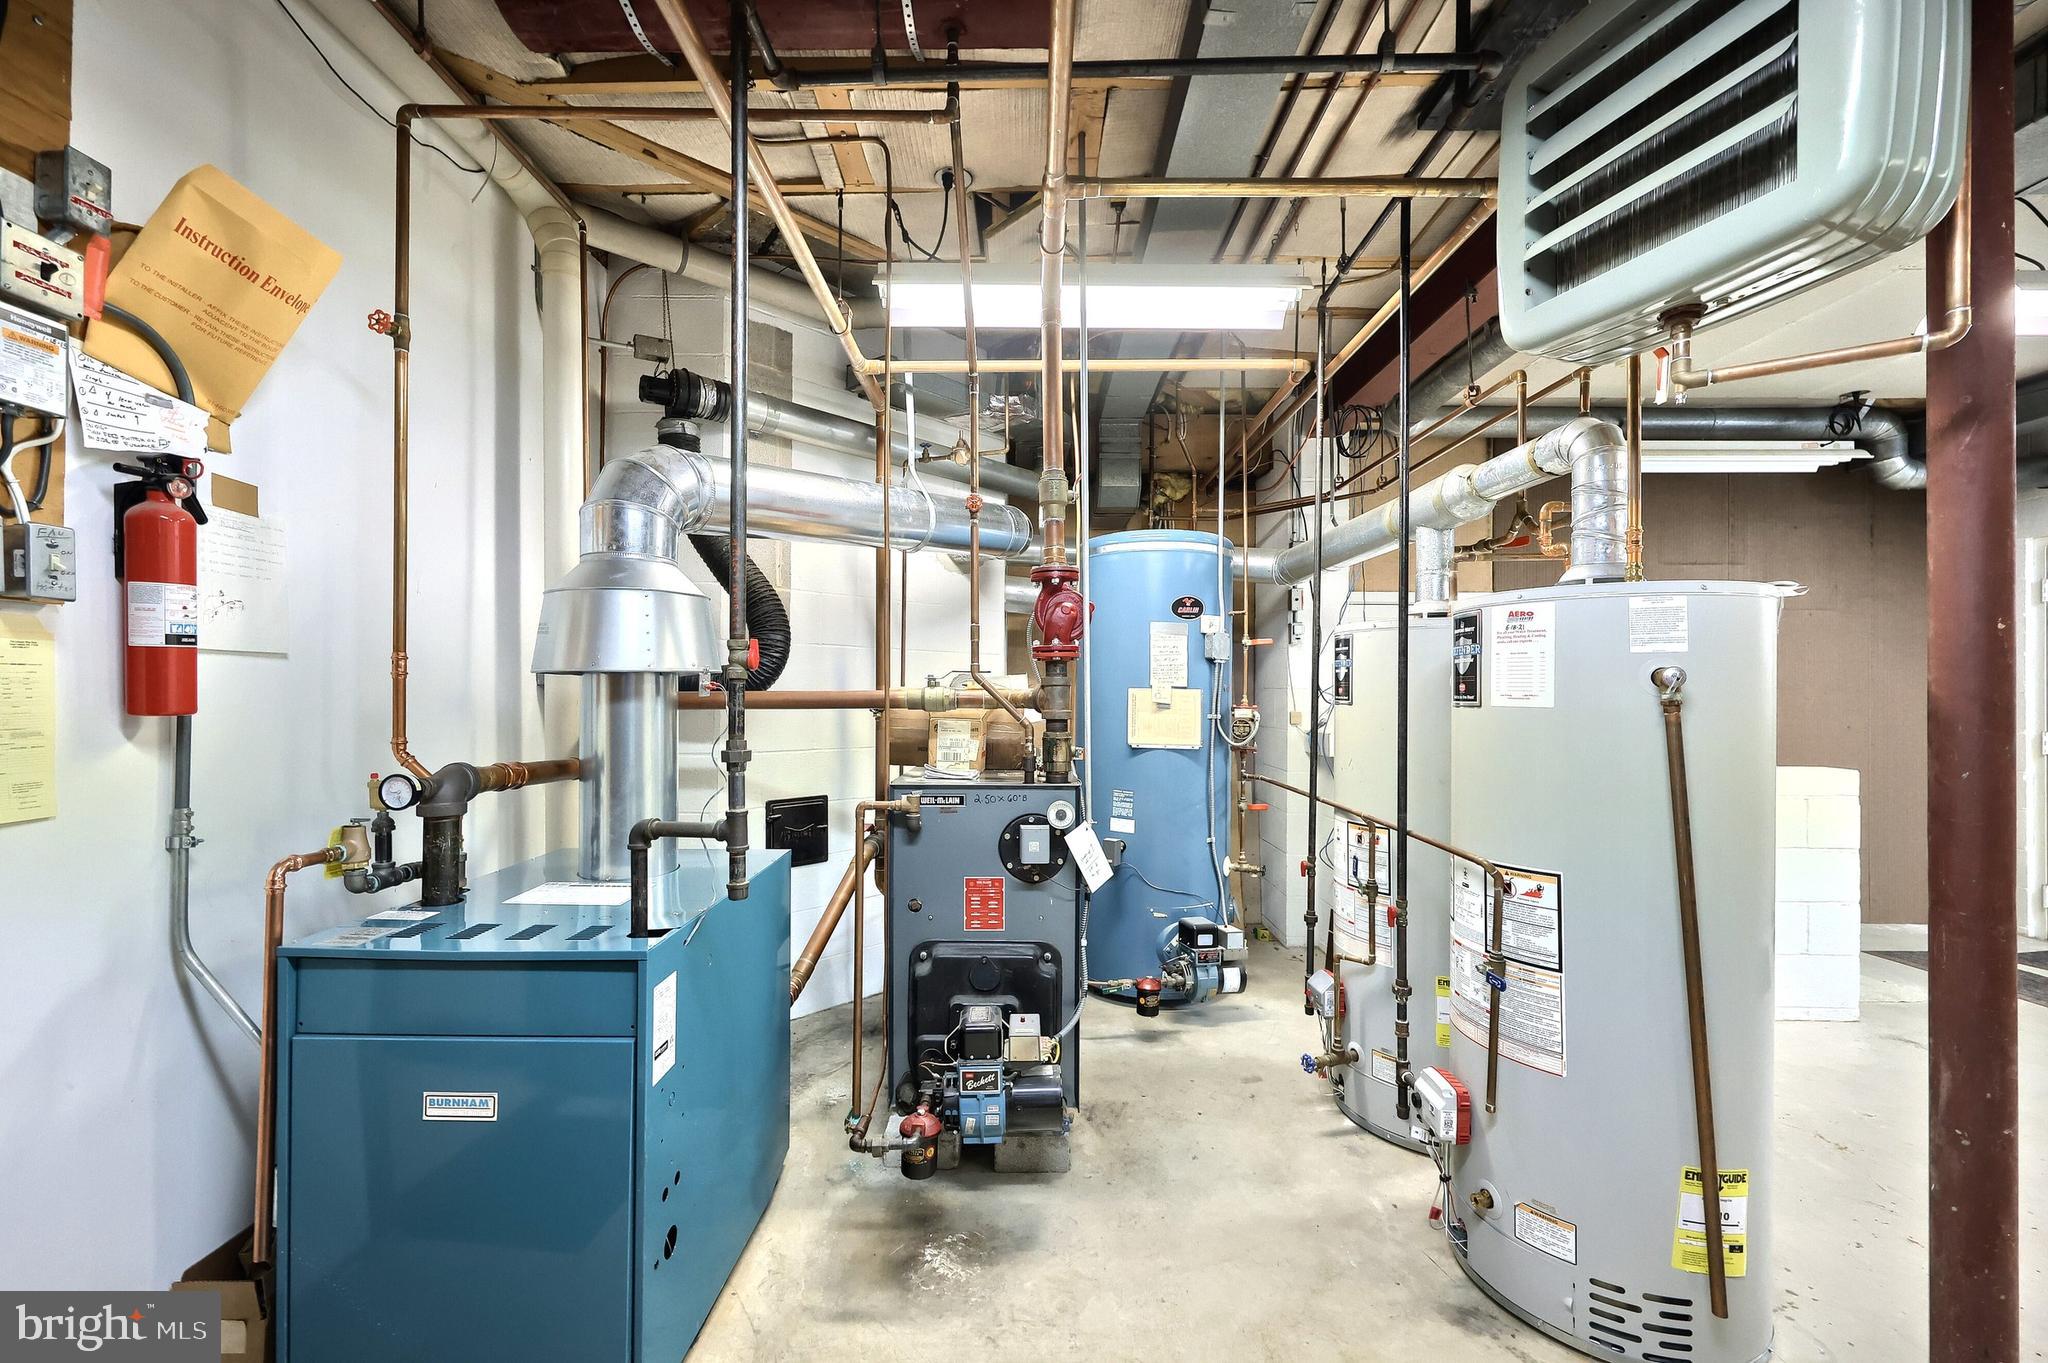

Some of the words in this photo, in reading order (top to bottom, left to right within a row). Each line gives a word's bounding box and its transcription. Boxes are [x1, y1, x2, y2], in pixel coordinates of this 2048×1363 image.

[174, 216, 261, 284] Instruction
[129, 278, 140, 288] TO
[140, 283, 155, 295] THE
[154, 291, 190, 315] CUSTOMER
[194, 314, 219, 333] RETAIN
[140, 262, 151, 272] TO
[152, 269, 166, 281] THE
[167, 278, 203, 302] INSTALLER
[207, 303, 228, 319] AFFIX
[229, 316, 250, 332] THESE
[9, 314, 52, 334] Honeywell
[18, 334, 55, 352] WARNING
[190, 321, 208, 334] FOR
[207, 331, 236, 349] FUTURE
[1508, 610, 1534, 618] AERO
[1510, 872, 1532, 880] WARNING
[965, 1073, 996, 1090] Beckett
[428, 1098, 489, 1107] BURNHAM
[1534, 1211, 1558, 1225] WARNING
